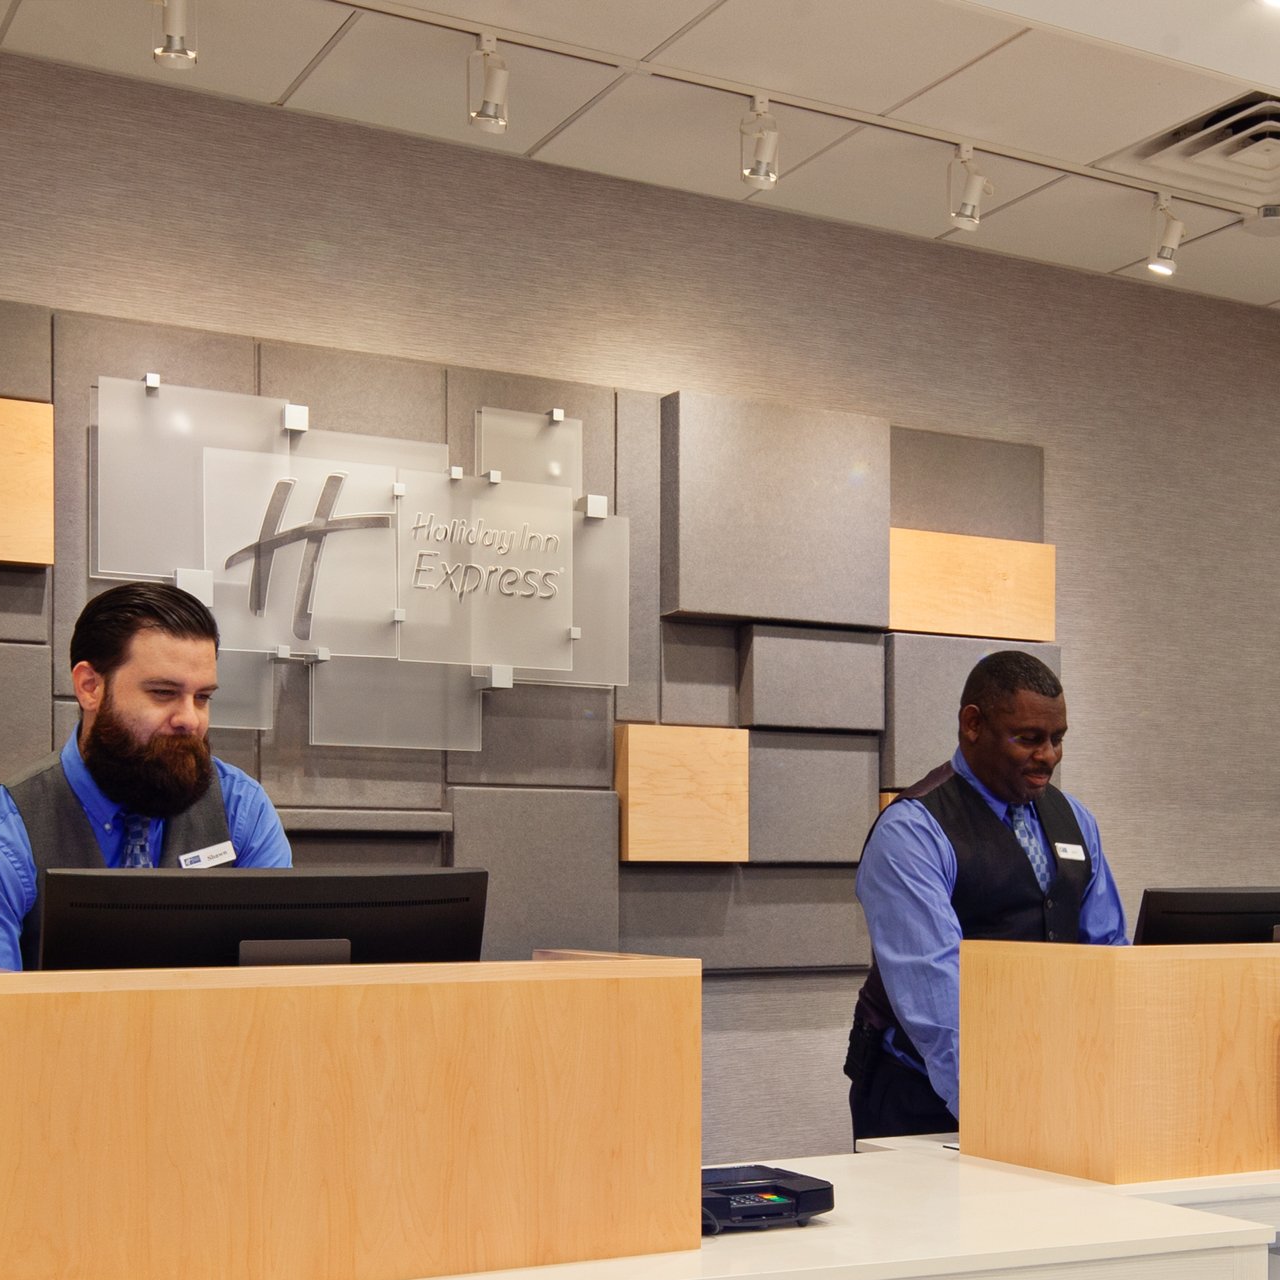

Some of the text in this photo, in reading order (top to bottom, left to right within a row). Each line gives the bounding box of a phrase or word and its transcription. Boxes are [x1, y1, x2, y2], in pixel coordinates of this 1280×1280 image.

[411, 512, 561, 555] Holiday Inn
[412, 550, 560, 603] Express
